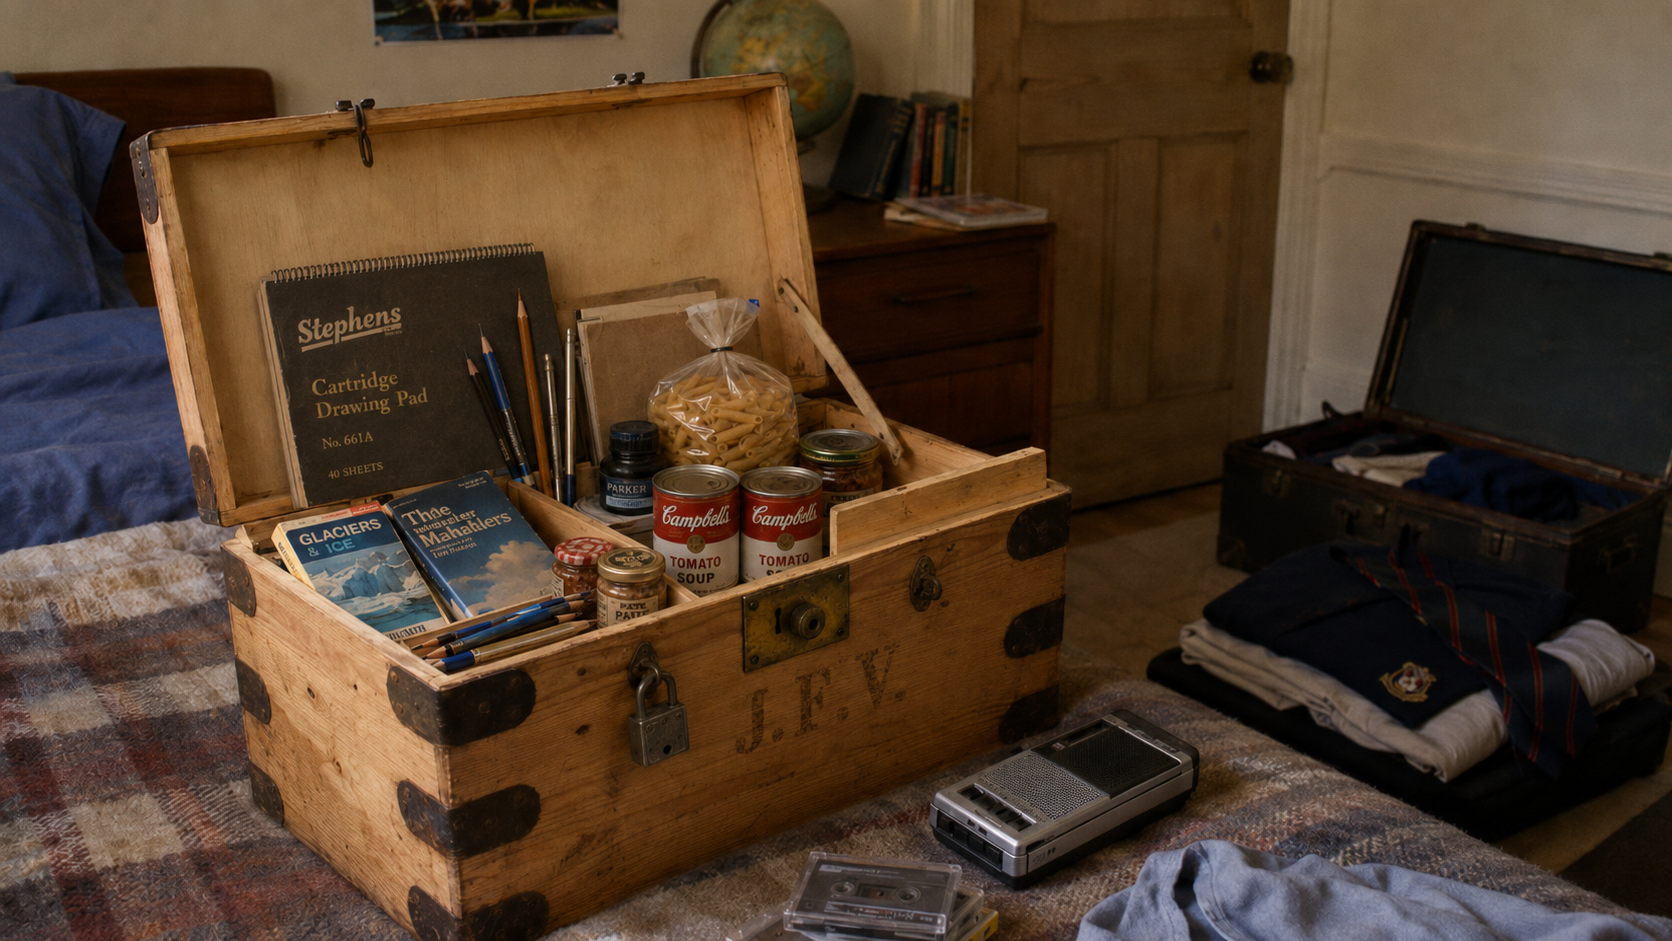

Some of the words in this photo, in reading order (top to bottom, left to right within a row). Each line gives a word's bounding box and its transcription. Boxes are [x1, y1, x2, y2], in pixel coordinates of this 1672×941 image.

[298, 306, 402, 345] Stephens
[311, 371, 399, 396] Cartridge
[315, 396, 391, 419] Drawing
[395, 387, 429, 407] Pad
[322, 437, 342, 450] No.
[344, 431, 374, 446] 661A
[328, 469, 340, 479] 40
[343, 461, 384, 477] SHEETS
[607, 482, 647, 495] PARKER
[299, 518, 382, 546] GLACIERS
[307, 547, 320, 557] &
[325, 538, 356, 554] ICE
[669, 555, 722, 570] TOMATO
[758, 552, 810, 568] TOMATO
[677, 572, 715, 585] SOUP
